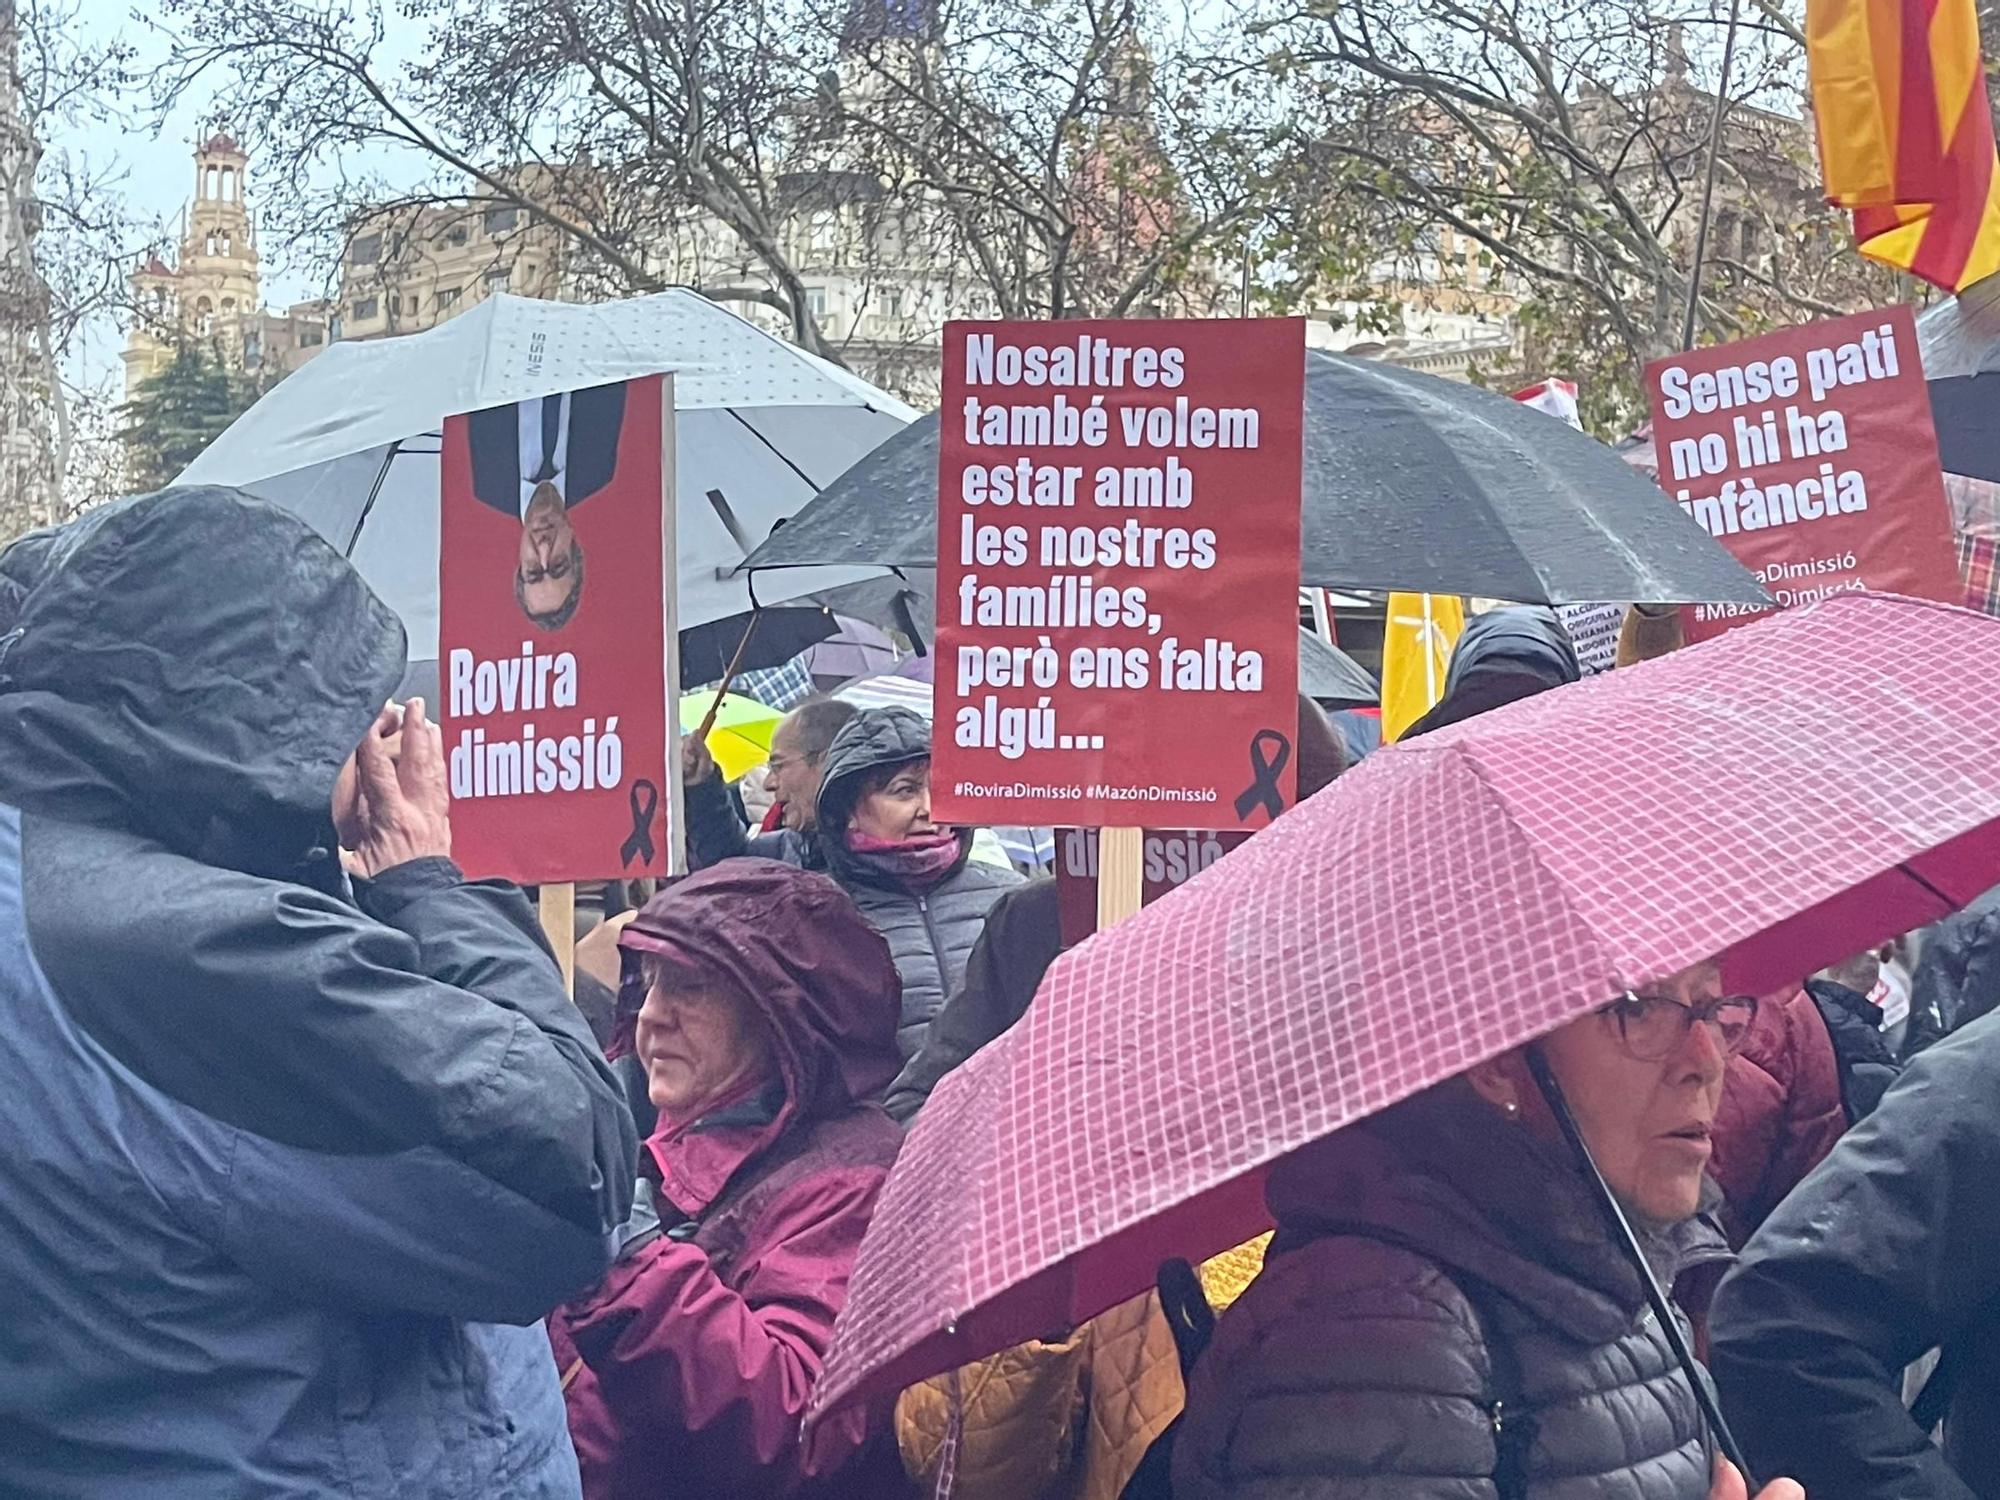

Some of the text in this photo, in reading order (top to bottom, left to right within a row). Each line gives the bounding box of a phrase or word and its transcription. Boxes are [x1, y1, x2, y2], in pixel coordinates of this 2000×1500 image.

[965, 334, 1185, 388] Nosaltres
[1660, 324, 1899, 420] Sense pati
[963, 395, 1259, 449] també volem
[1669, 406, 1848, 481] no hi ha
[962, 457, 1193, 509] estar amb
[960, 514, 1217, 569] les nostres
[1755, 550, 1857, 584] aDimissió
[958, 575, 1162, 635] famílies,
[450, 640, 577, 717] Rovira
[957, 636, 1263, 697] però ens falta
[955, 694, 1104, 759] algú...
[450, 715, 622, 799] dimissió
[954, 782, 1217, 802] #RoviraDimissió #MazónDimissió
